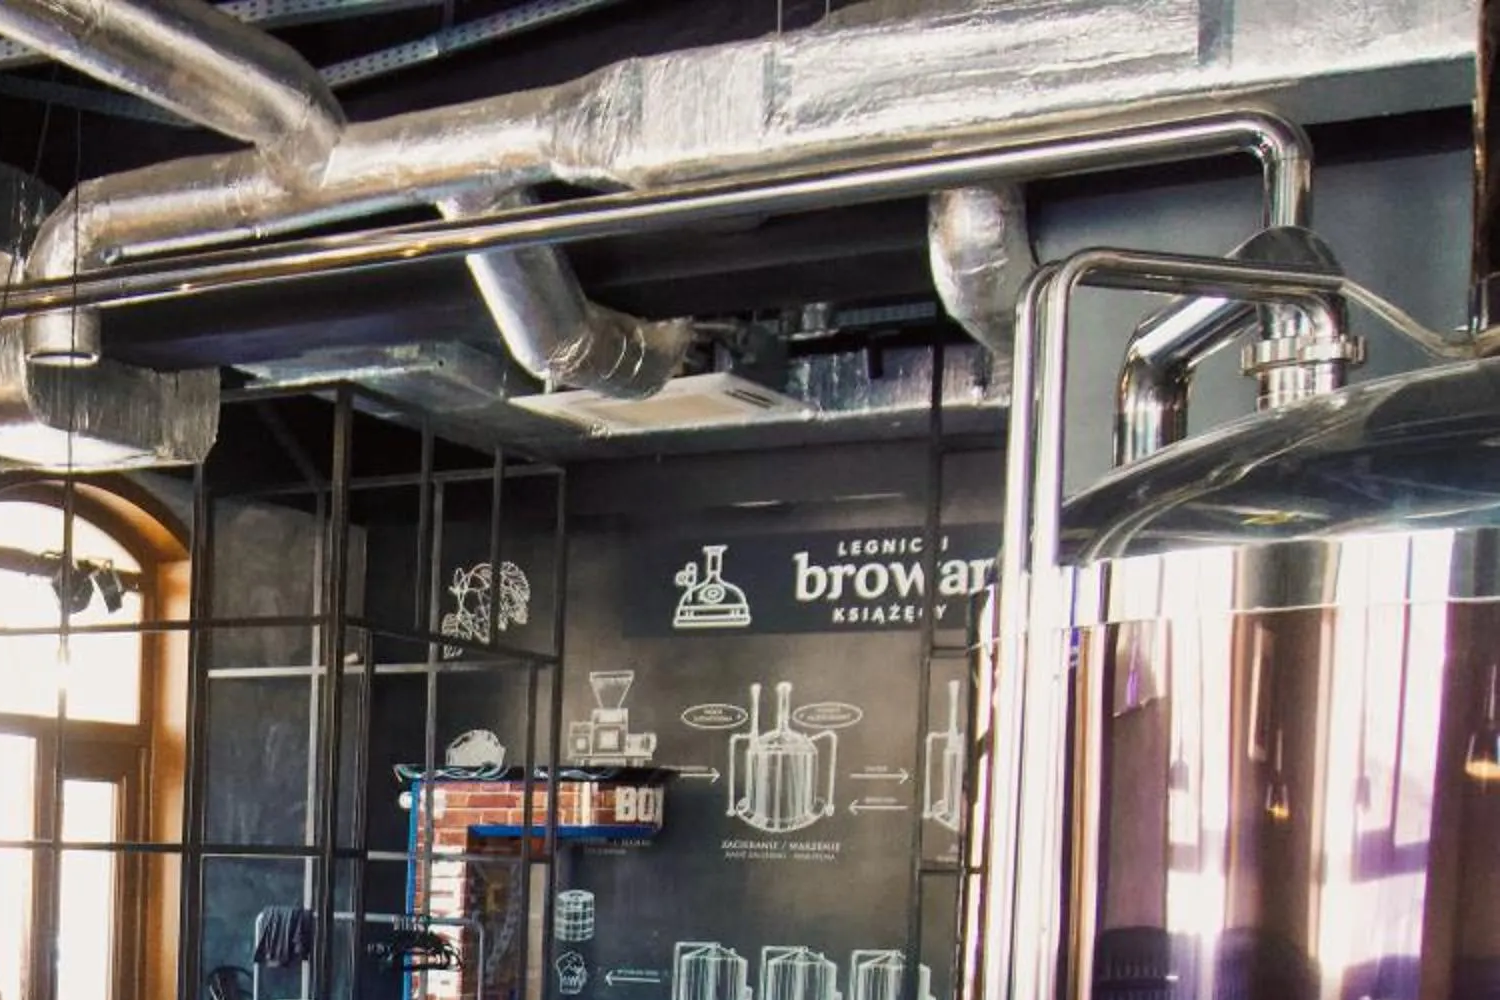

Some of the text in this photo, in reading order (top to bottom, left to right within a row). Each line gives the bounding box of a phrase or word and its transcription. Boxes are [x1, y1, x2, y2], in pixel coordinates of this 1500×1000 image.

[836, 535, 950, 557] LEGNICI
[792, 551, 1000, 602] browar
[831, 603, 948, 625] KSIĄŻĘY
